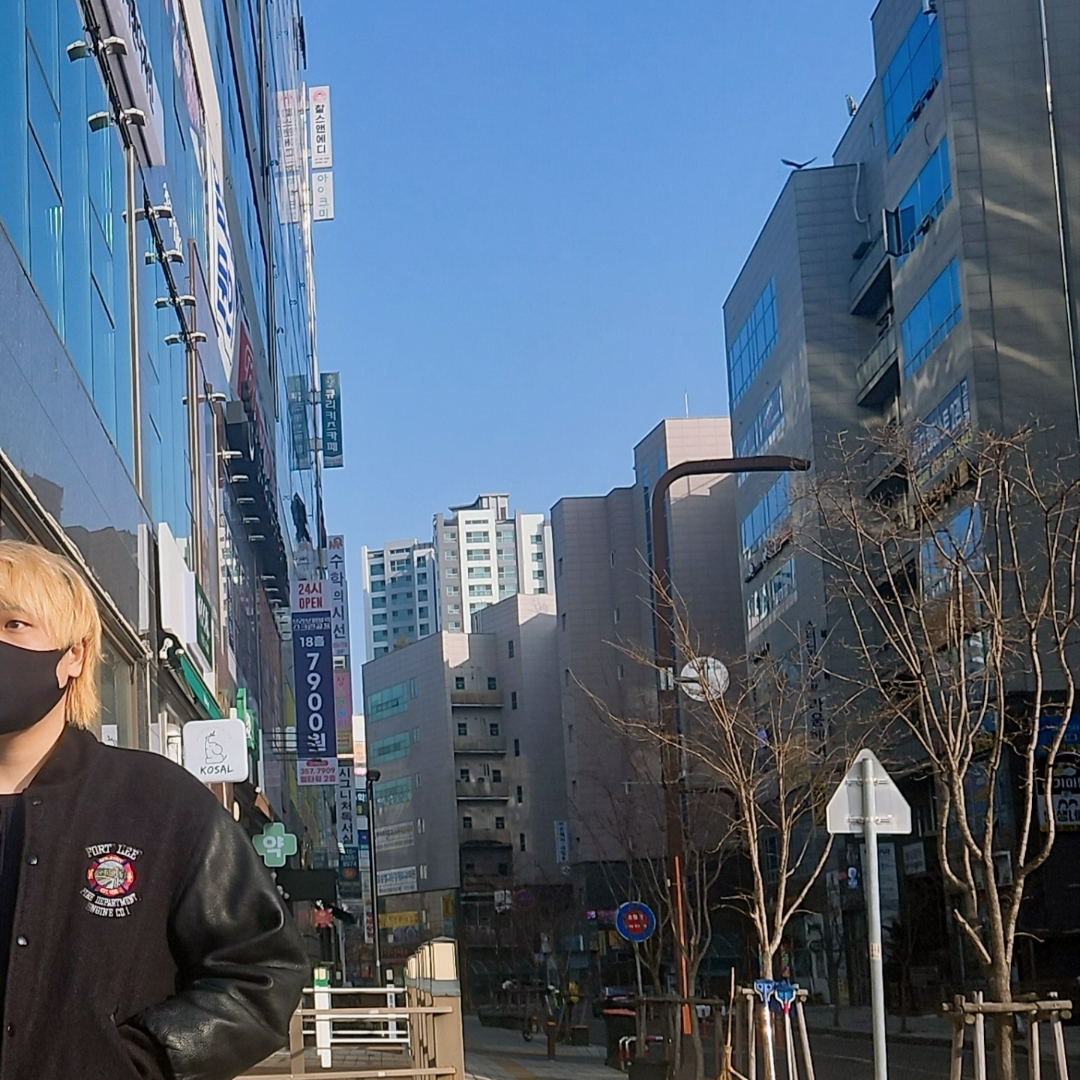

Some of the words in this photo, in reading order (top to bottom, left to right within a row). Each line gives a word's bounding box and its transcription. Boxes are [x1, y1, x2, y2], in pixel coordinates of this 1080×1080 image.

[298, 582, 323, 595] 24시
[330, 553, 346, 640] 수학의시선
[298, 597, 323, 610] OPEN
[199, 764, 234, 776] KOSAL
[338, 767, 355, 845] 시그니처독서실
[85, 843, 113, 858] FORT
[116, 844, 140, 861] LEE
[262, 836, 285, 858] 약
[85, 902, 114, 918] ENGINE
